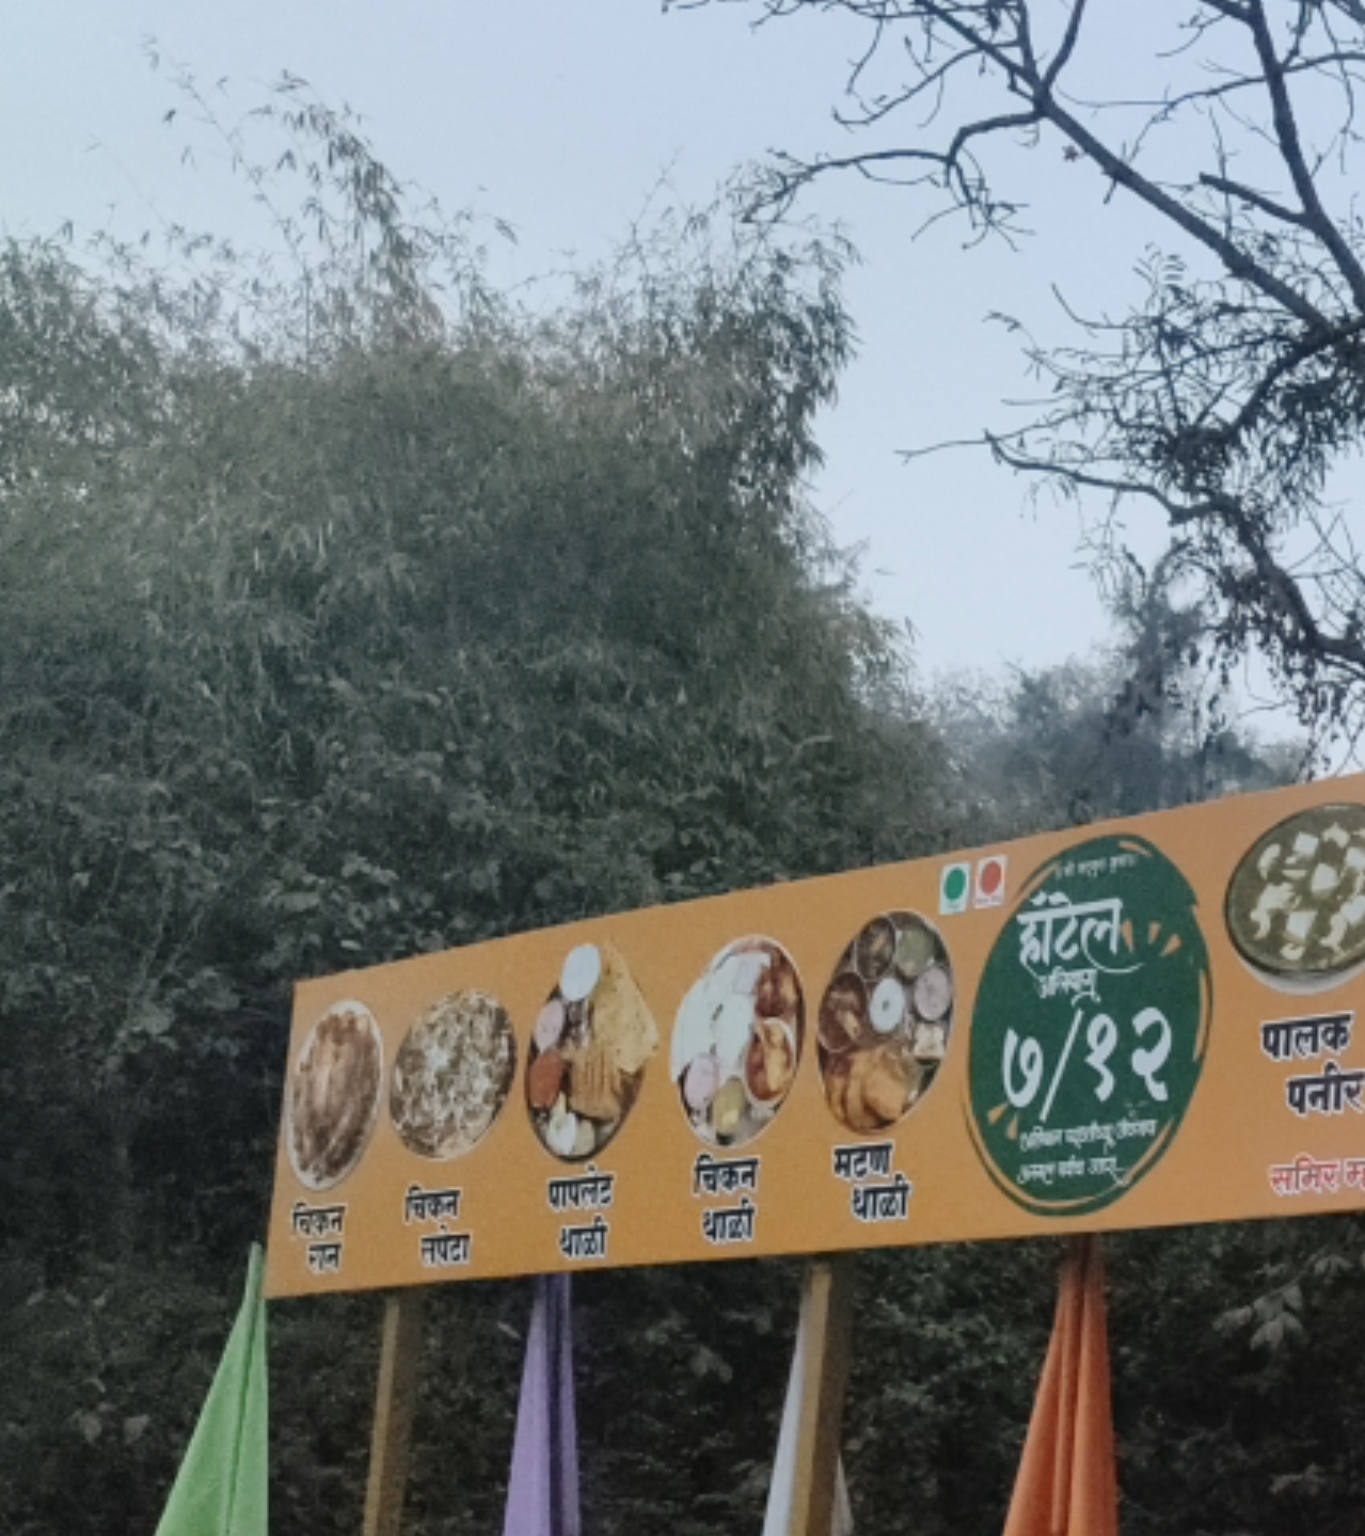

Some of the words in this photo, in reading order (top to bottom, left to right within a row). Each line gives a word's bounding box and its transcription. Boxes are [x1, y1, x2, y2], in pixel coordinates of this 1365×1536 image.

[1261, 1013, 1352, 1057] पालक
[693, 1154, 759, 1195] चिकन
[404, 1185, 461, 1222] चिकन
[853, 1174, 910, 1219] थाळी
[560, 1216, 608, 1258] थाळी
[703, 1200, 755, 1242] थाळी
